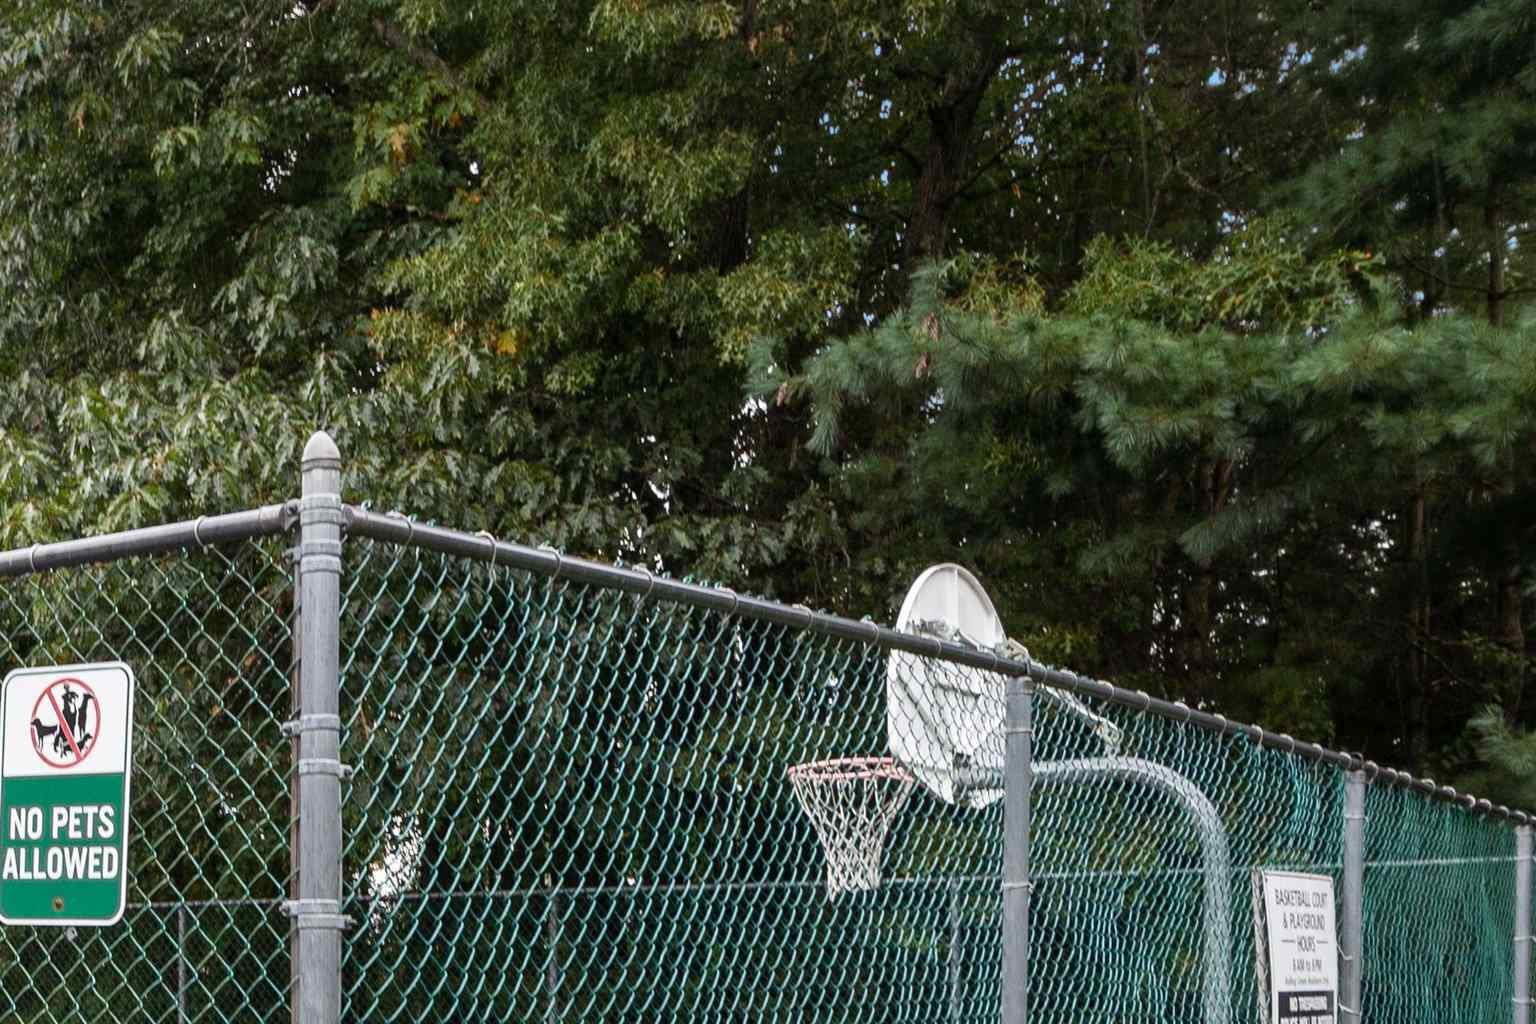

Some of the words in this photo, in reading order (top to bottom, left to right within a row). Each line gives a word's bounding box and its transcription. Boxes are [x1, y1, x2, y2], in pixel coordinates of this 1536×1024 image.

[9, 806, 43, 840] NO
[52, 804, 114, 839] PETS
[2, 846, 119, 880] ALLOWED
